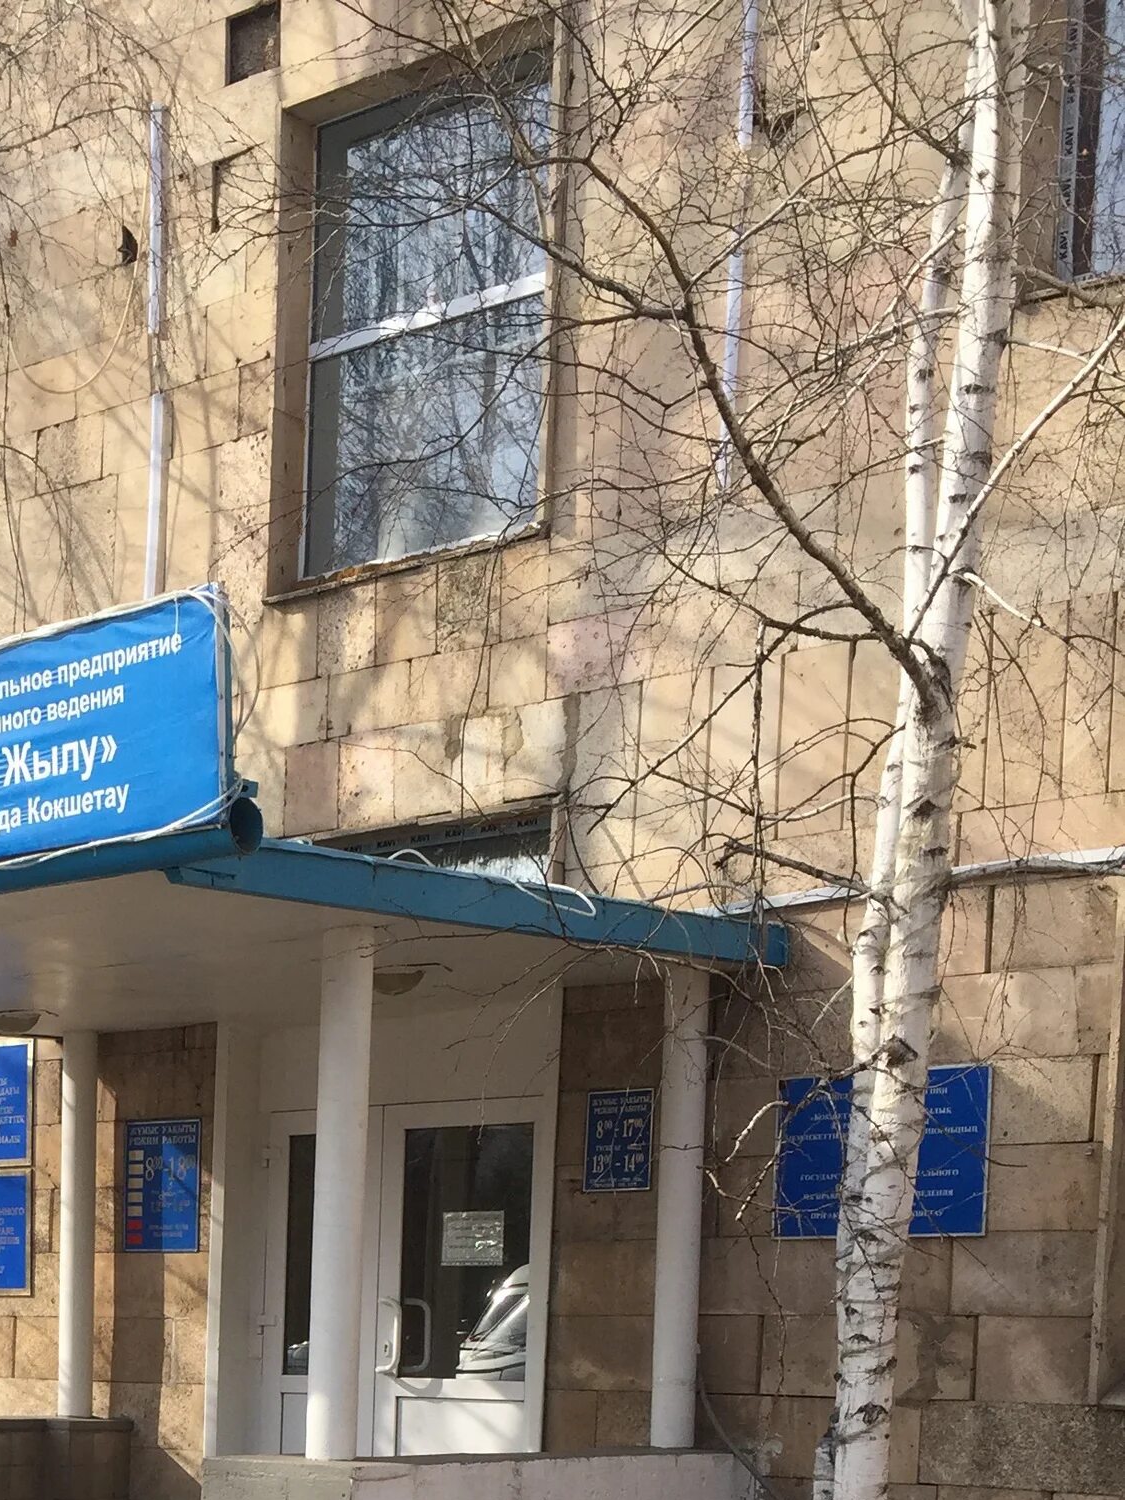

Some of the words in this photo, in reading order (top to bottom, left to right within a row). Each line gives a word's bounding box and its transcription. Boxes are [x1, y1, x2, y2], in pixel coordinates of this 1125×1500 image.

[1063, 126, 1075, 156] KAVI
[1058, 229, 1069, 261] KAVI
[57, 633, 182, 687] предприятие
[47, 685, 124, 721] ведения
[1, 734, 118, 787] Жылу»
[27, 783, 130, 825] Кокшетау
[377, 840, 396, 848] KAVI
[410, 833, 430, 843] KAVI
[517, 817, 539, 828] KAVI
